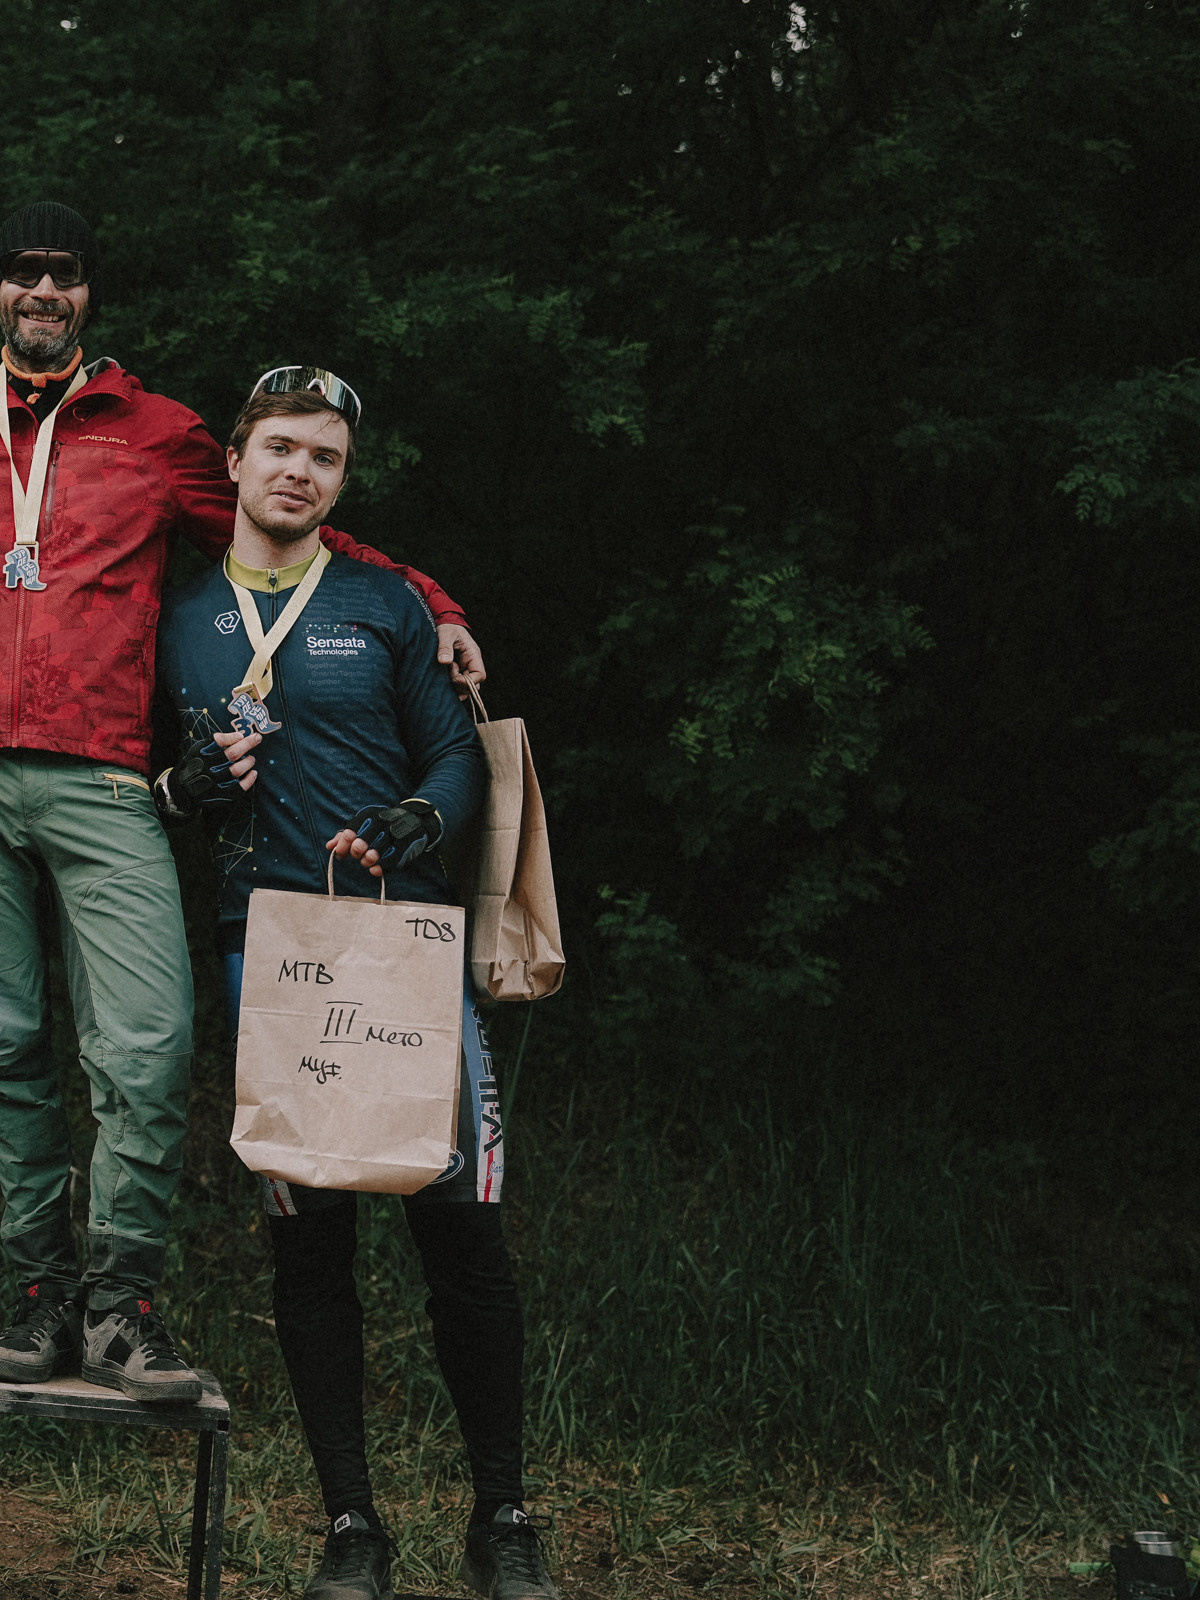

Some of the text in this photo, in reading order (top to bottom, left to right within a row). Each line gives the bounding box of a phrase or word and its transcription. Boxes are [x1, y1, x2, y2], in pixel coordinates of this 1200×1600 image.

[306, 636, 366, 649] Sensata
[234, 694, 248, 707] ТУР
[234, 718, 252, 738] 3
[277, 959, 334, 985] MTB
